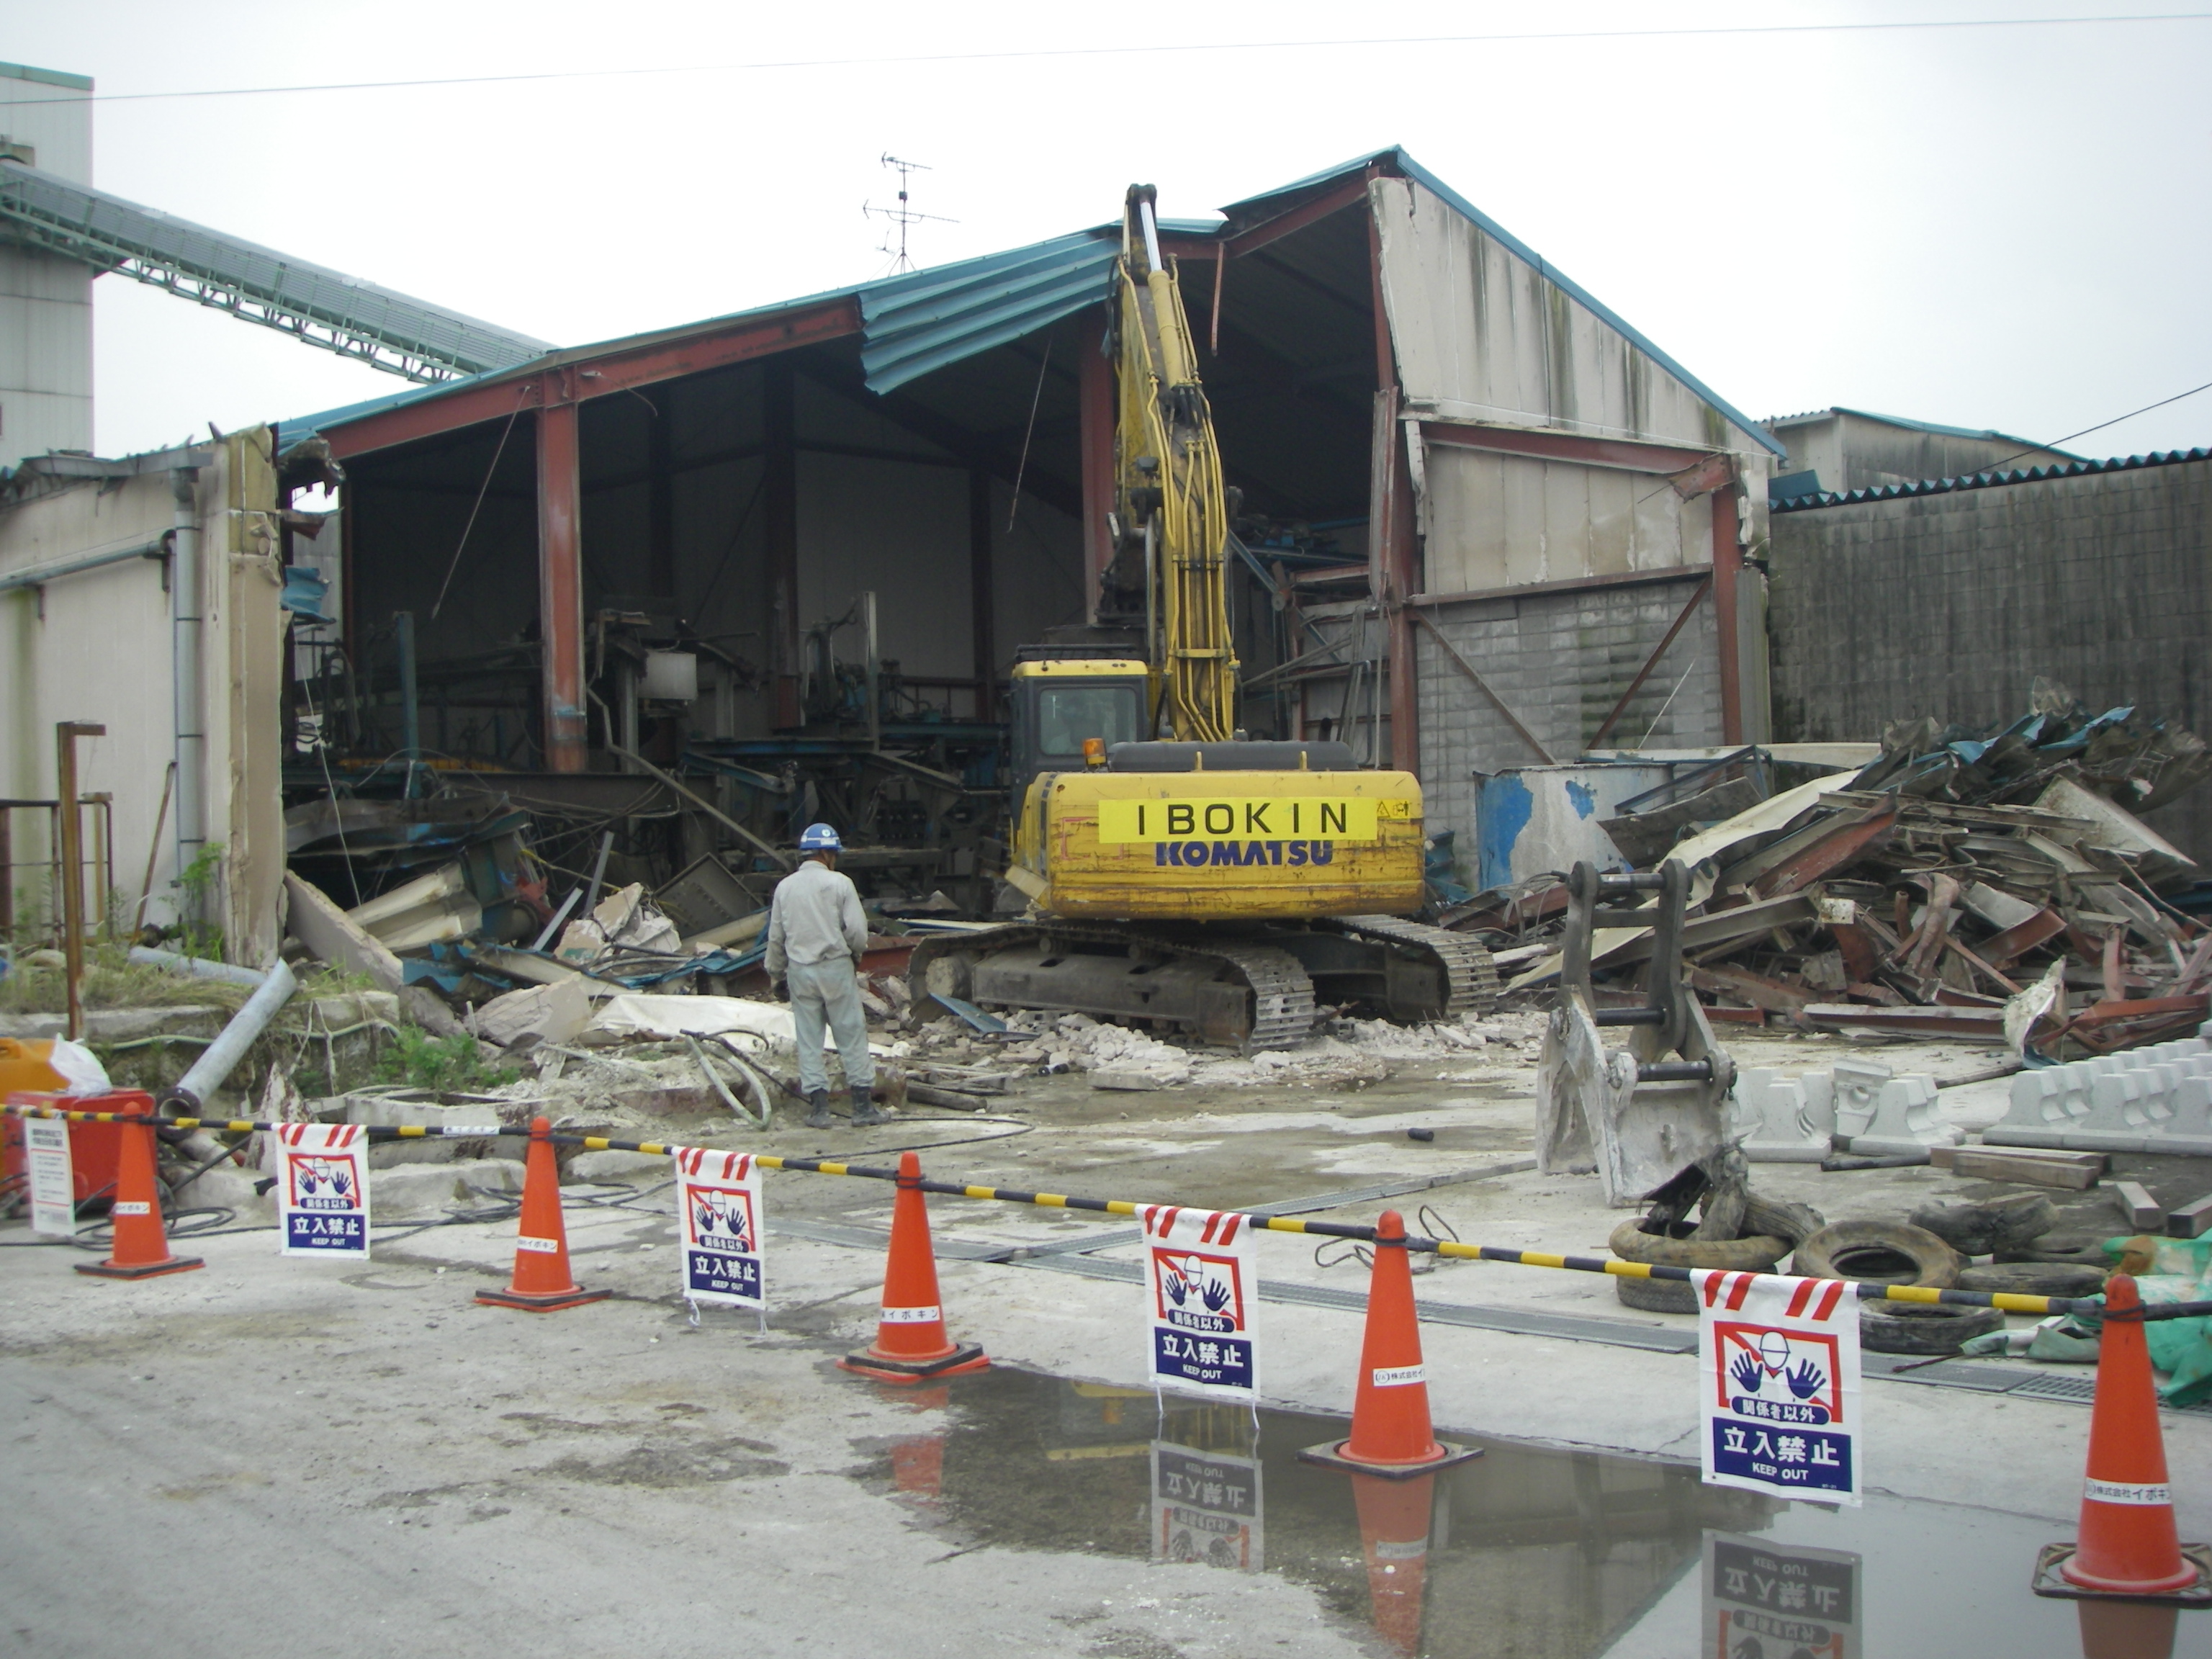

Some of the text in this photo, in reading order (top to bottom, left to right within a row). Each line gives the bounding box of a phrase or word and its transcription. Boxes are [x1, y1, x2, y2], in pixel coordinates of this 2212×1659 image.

[1156, 840, 1334, 866] KOMATSU
[293, 1216, 361, 1236] 立入禁止
[311, 1237, 330, 1246] KEEP
[694, 1255, 757, 1282] 立入禁止
[711, 1279, 744, 1292] KEEP OUT
[881, 1310, 938, 1320] イボキン
[1162, 1334, 1244, 1367] 立入禁止
[1182, 1363, 1223, 1380] KEEP OUT
[1742, 1398, 1816, 1423] 関係者以外
[1723, 1426, 1840, 1467] 立入禁止
[1752, 1462, 1809, 1480] KEEP OUT
